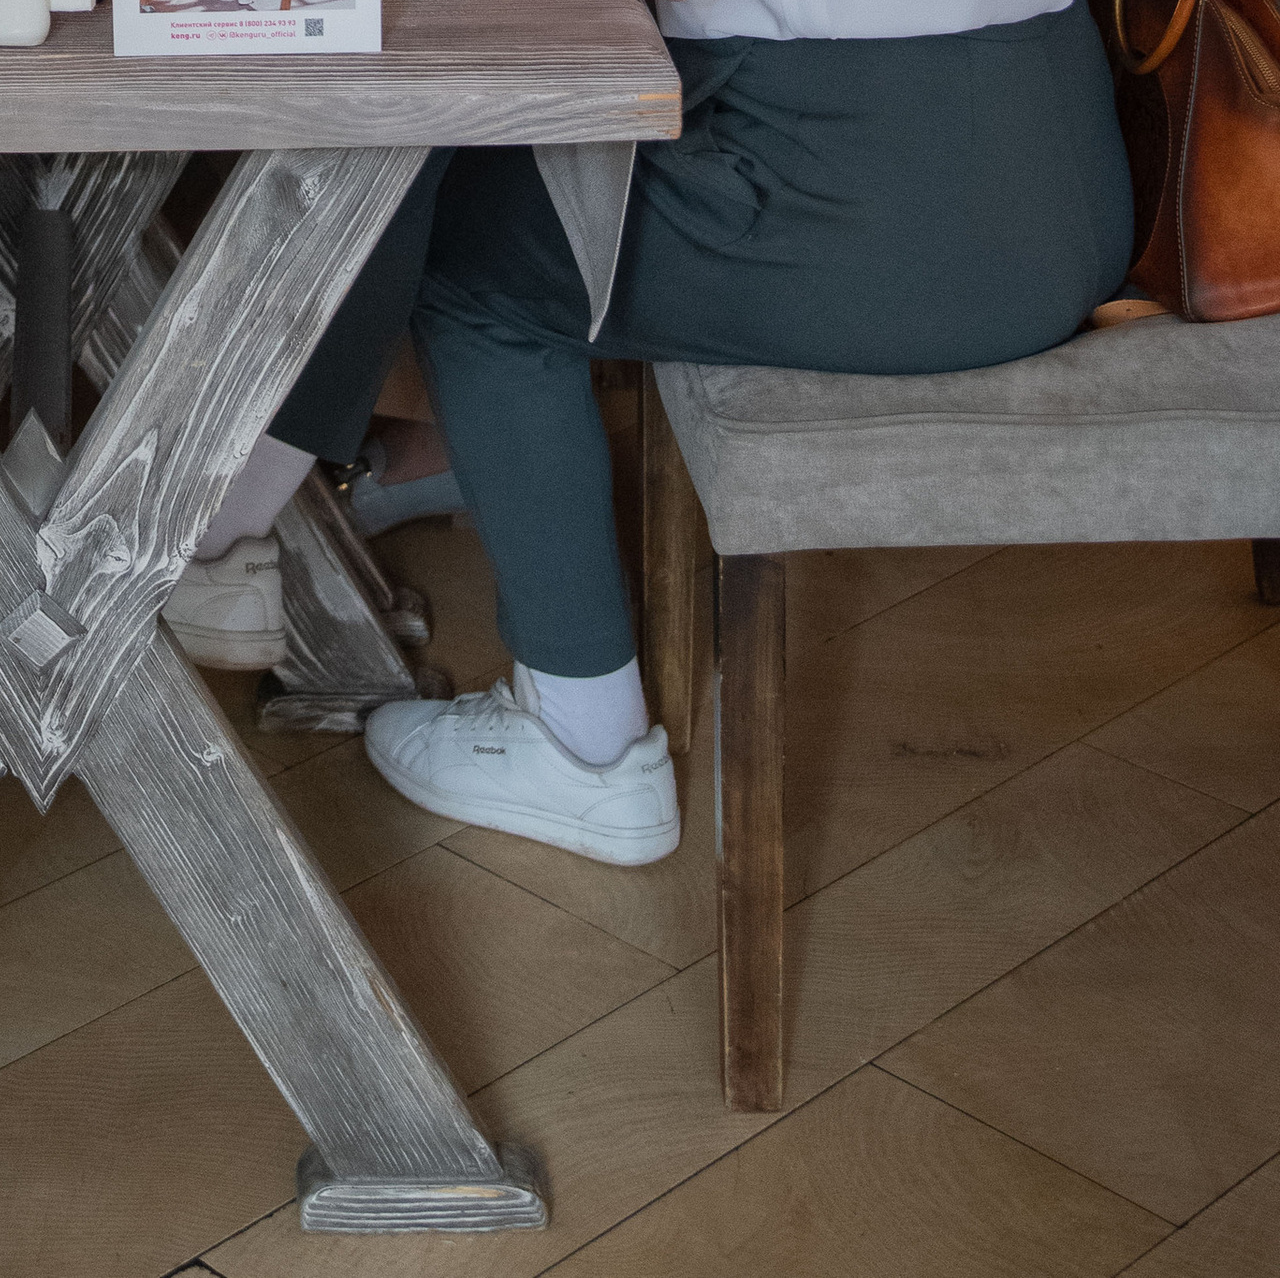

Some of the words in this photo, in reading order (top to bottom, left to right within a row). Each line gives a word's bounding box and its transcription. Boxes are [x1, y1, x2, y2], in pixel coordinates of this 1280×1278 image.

[170, 21, 212, 29] Клиентский
[245, 19, 263, 27] (800)
[278, 19, 286, 27] 93
[170, 32, 201, 41] keng.ru
[473, 745, 506, 755] Reebok
